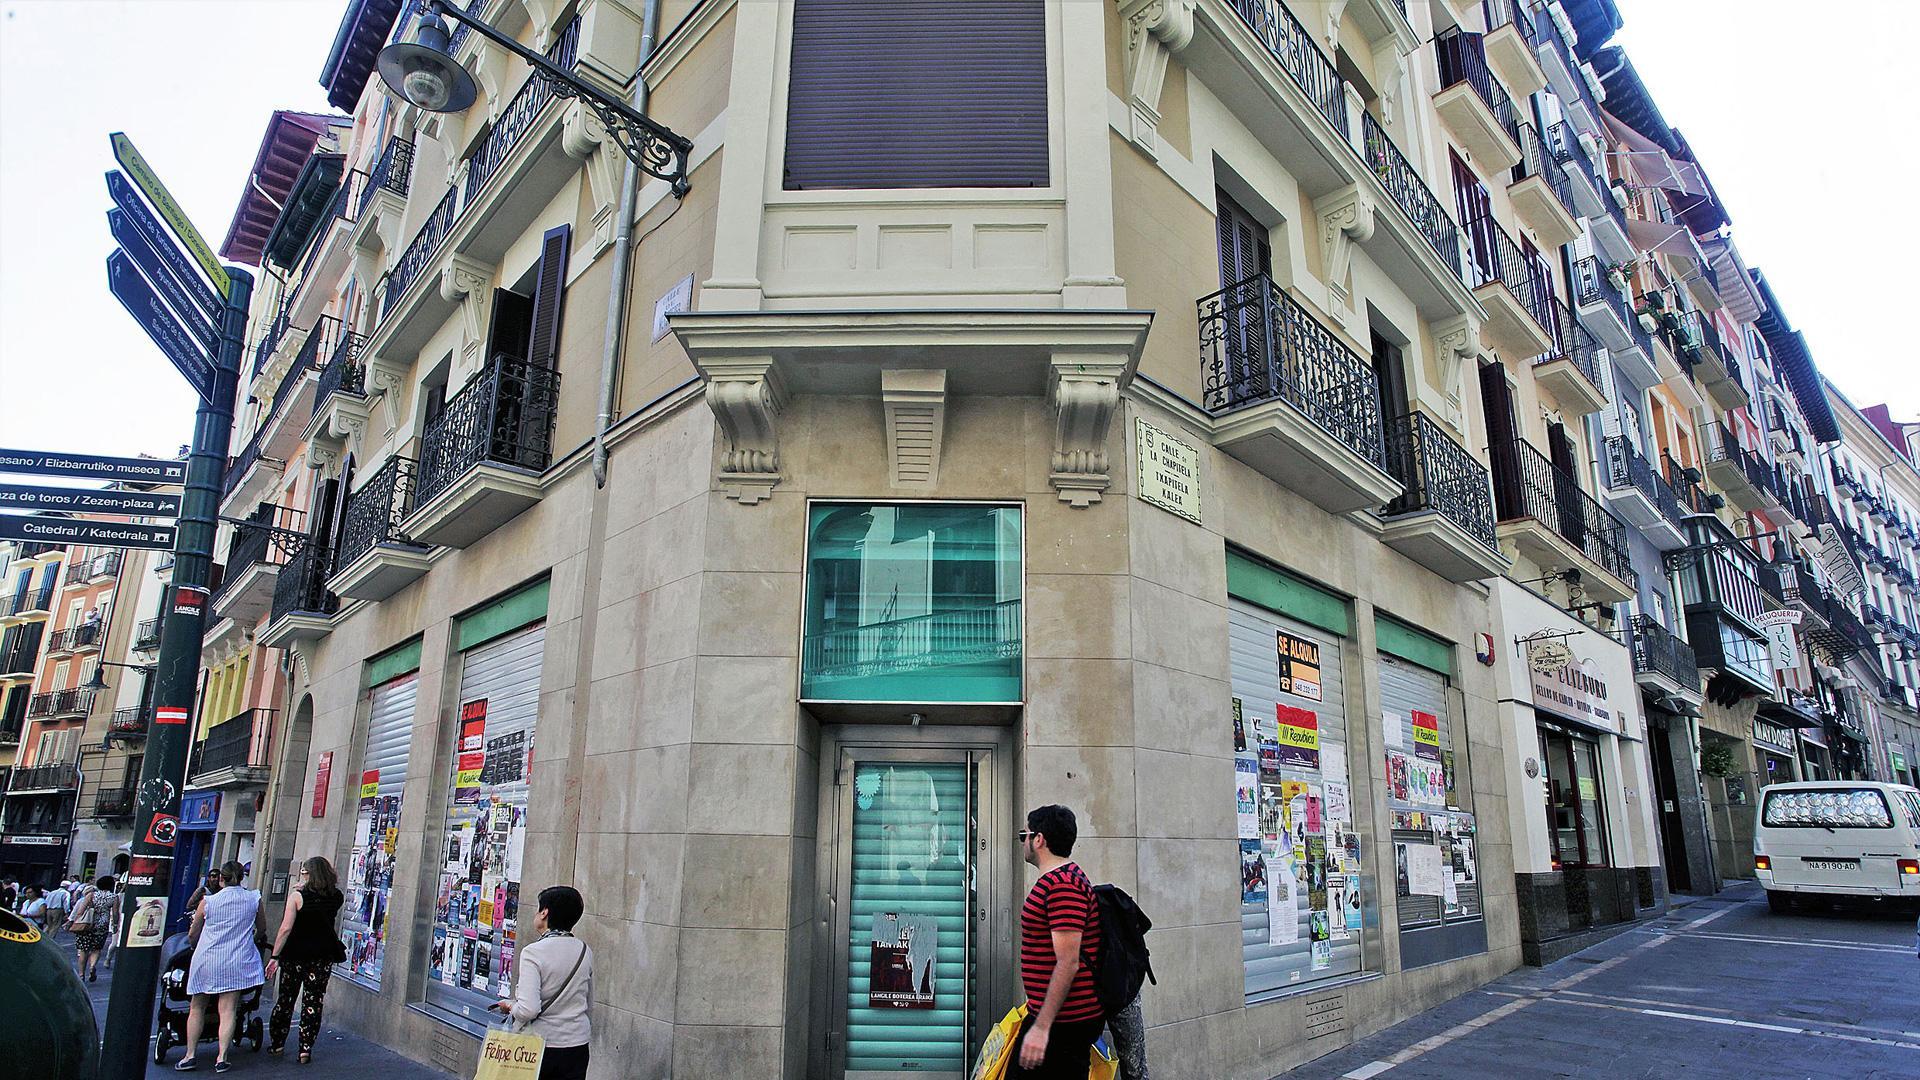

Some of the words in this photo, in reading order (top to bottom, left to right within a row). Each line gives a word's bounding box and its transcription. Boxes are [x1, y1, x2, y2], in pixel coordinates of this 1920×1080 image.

[126, 193, 147, 224] Oficina
[1161, 442, 1180, 460] CALLE
[36, 458, 43, 466] /
[45, 458, 114, 471] Elizbarrutiko
[117, 464, 160, 475] museoa
[1150, 450, 1158, 462] LA
[1162, 456, 1192, 479] CHAPITELA
[1155, 471, 1189, 496] TXAPITELA
[0, 492, 16, 500] za
[19, 492, 36, 501] de
[39, 493, 71, 504] toros
[73, 495, 80, 504] /
[81, 495, 154, 509] Zezen-plaza
[1162, 488, 1183, 506] KALEA
[23, 523, 79, 536] Catedral
[80, 528, 87, 537] /
[90, 528, 149, 541] Katedrala
[1755, 611, 1799, 623] PELUQUERIA
[1278, 635, 1289, 656] SE
[1290, 639, 1319, 666] ALQUILA
[1775, 626, 1792, 667] JUANY
[1558, 667, 1608, 701] ELIZBURU
[484, 1042, 512, 1063] Felipe
[514, 1046, 538, 1064] Cruz
